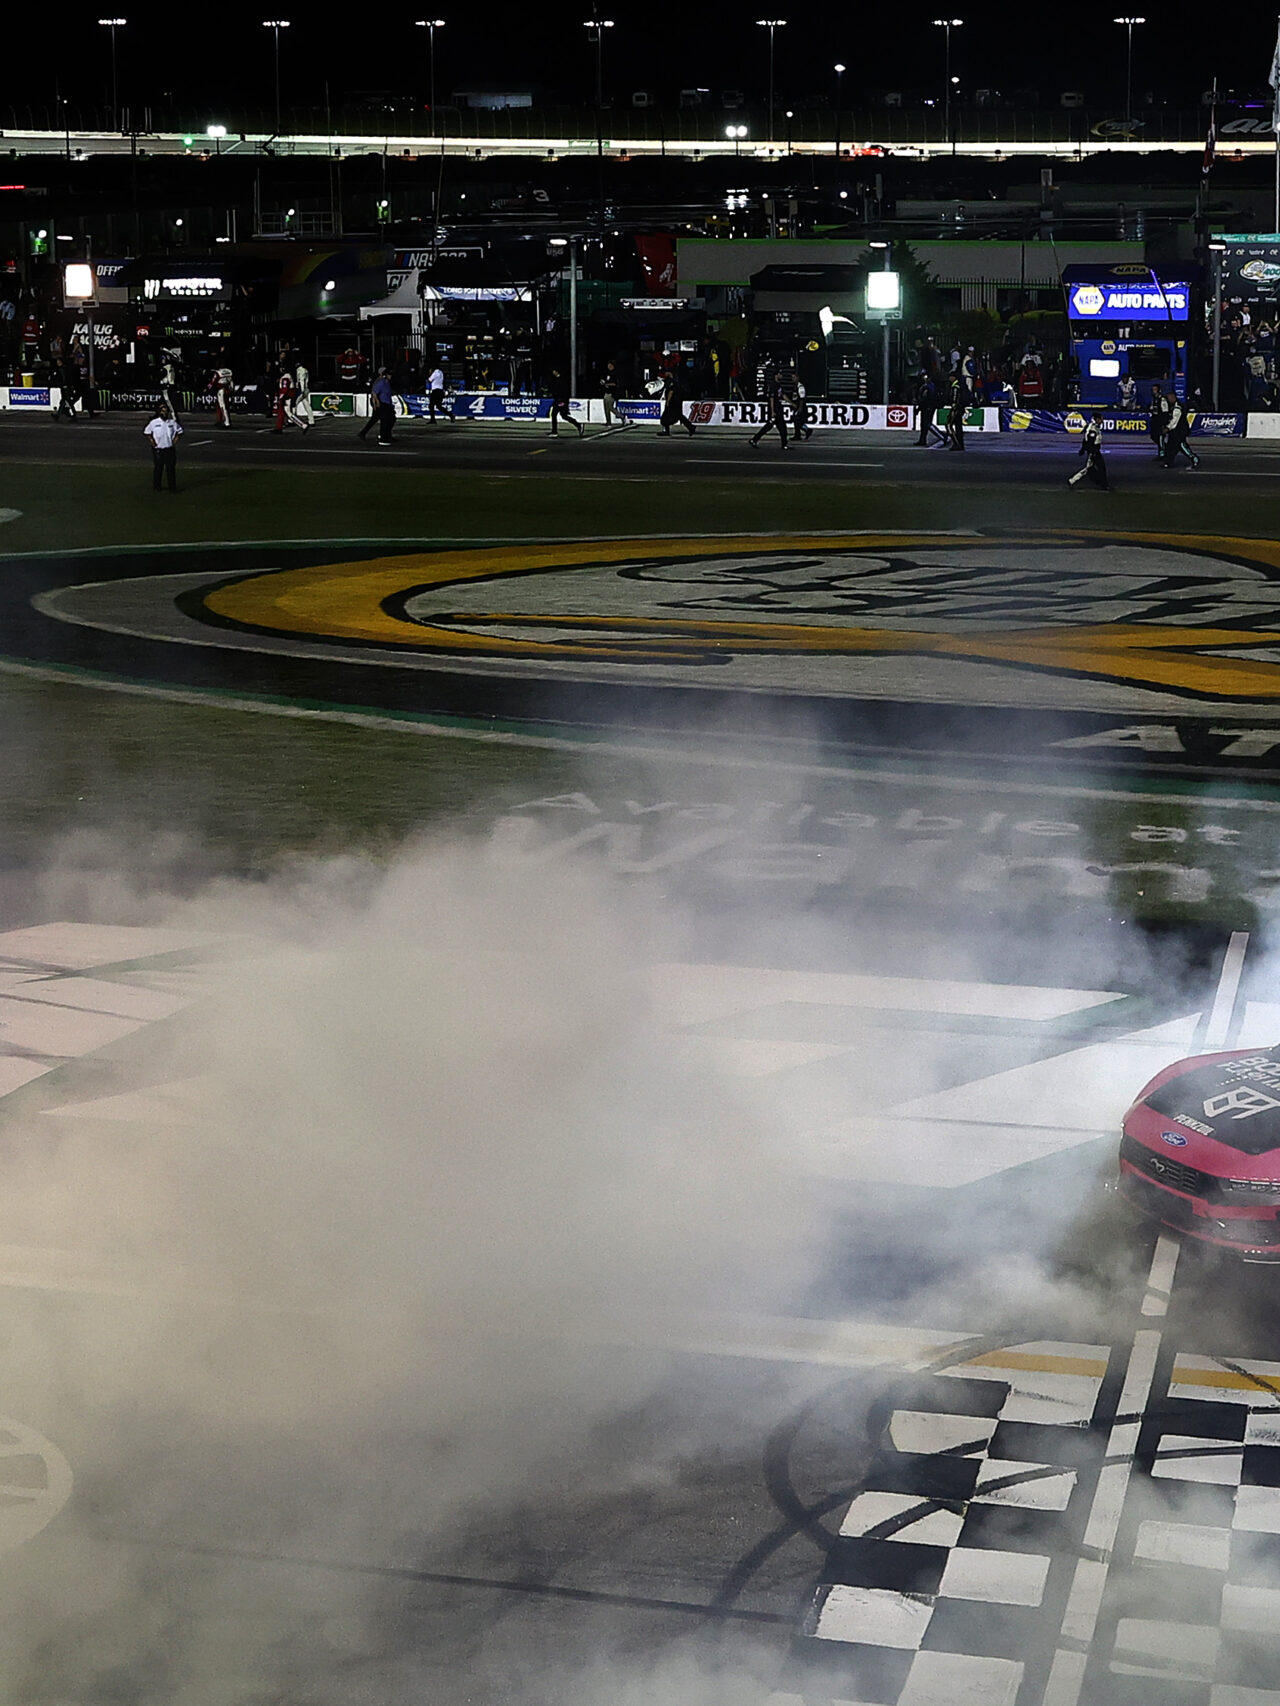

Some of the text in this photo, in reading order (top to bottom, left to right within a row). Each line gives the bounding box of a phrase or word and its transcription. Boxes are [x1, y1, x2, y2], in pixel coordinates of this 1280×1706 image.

[532, 188, 550, 202] 3
[1078, 293, 1186, 309] NAPA AUTO PARTS
[69, 334, 111, 346] RACNG
[10, 393, 40, 401] Walmart
[112, 393, 162, 402] MONSTER
[196, 394, 248, 404] MONER
[521, 398, 540, 406] JOHN
[468, 395, 485, 414] 4
[505, 405, 538, 414] SILVER'S
[688, 401, 717, 424] 19
[803, 404, 870, 427] BIRD
[1116, 420, 1147, 431] PARTS
[1201, 416, 1238, 428] Hendrick
[511, 792, 1244, 846] Available at
